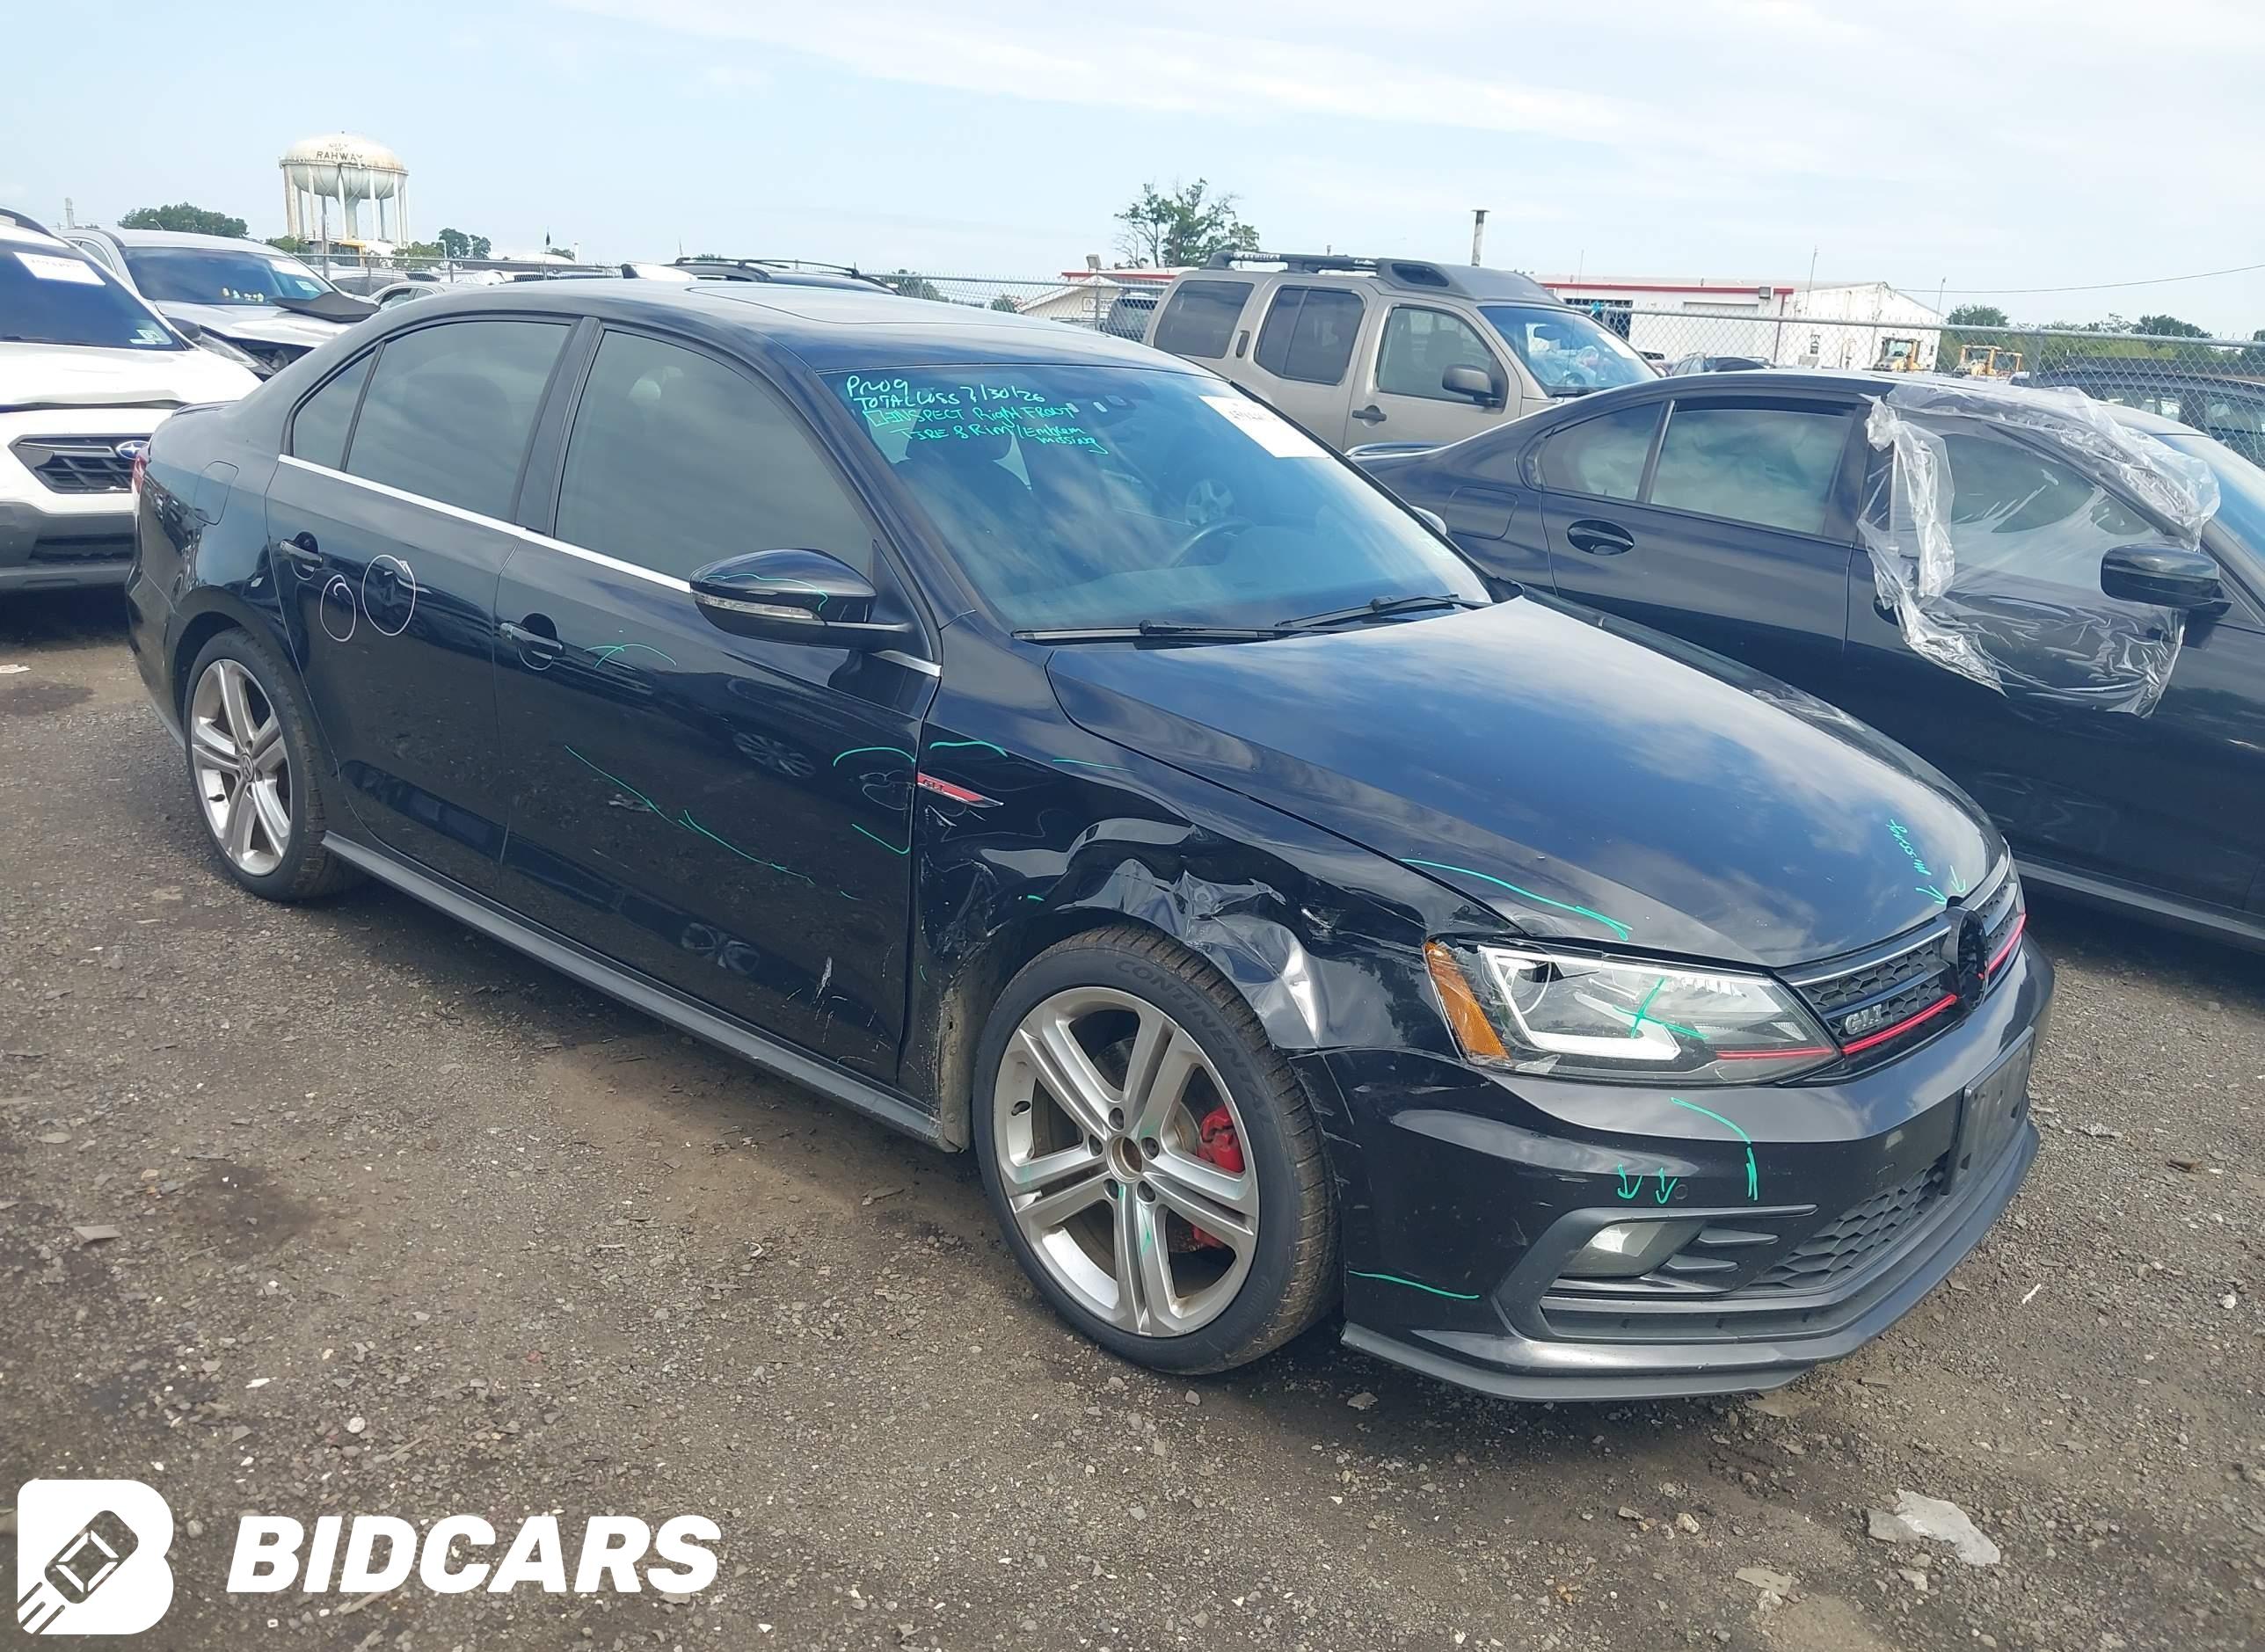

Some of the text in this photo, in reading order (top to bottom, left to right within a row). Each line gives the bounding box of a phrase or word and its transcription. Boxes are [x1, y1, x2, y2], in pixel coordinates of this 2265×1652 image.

[317, 150, 363, 162] RAHWAY
[853, 394, 916, 411] TOTAL
[921, 778, 944, 792] GLI
[1845, 1003, 1884, 1035] GLI
